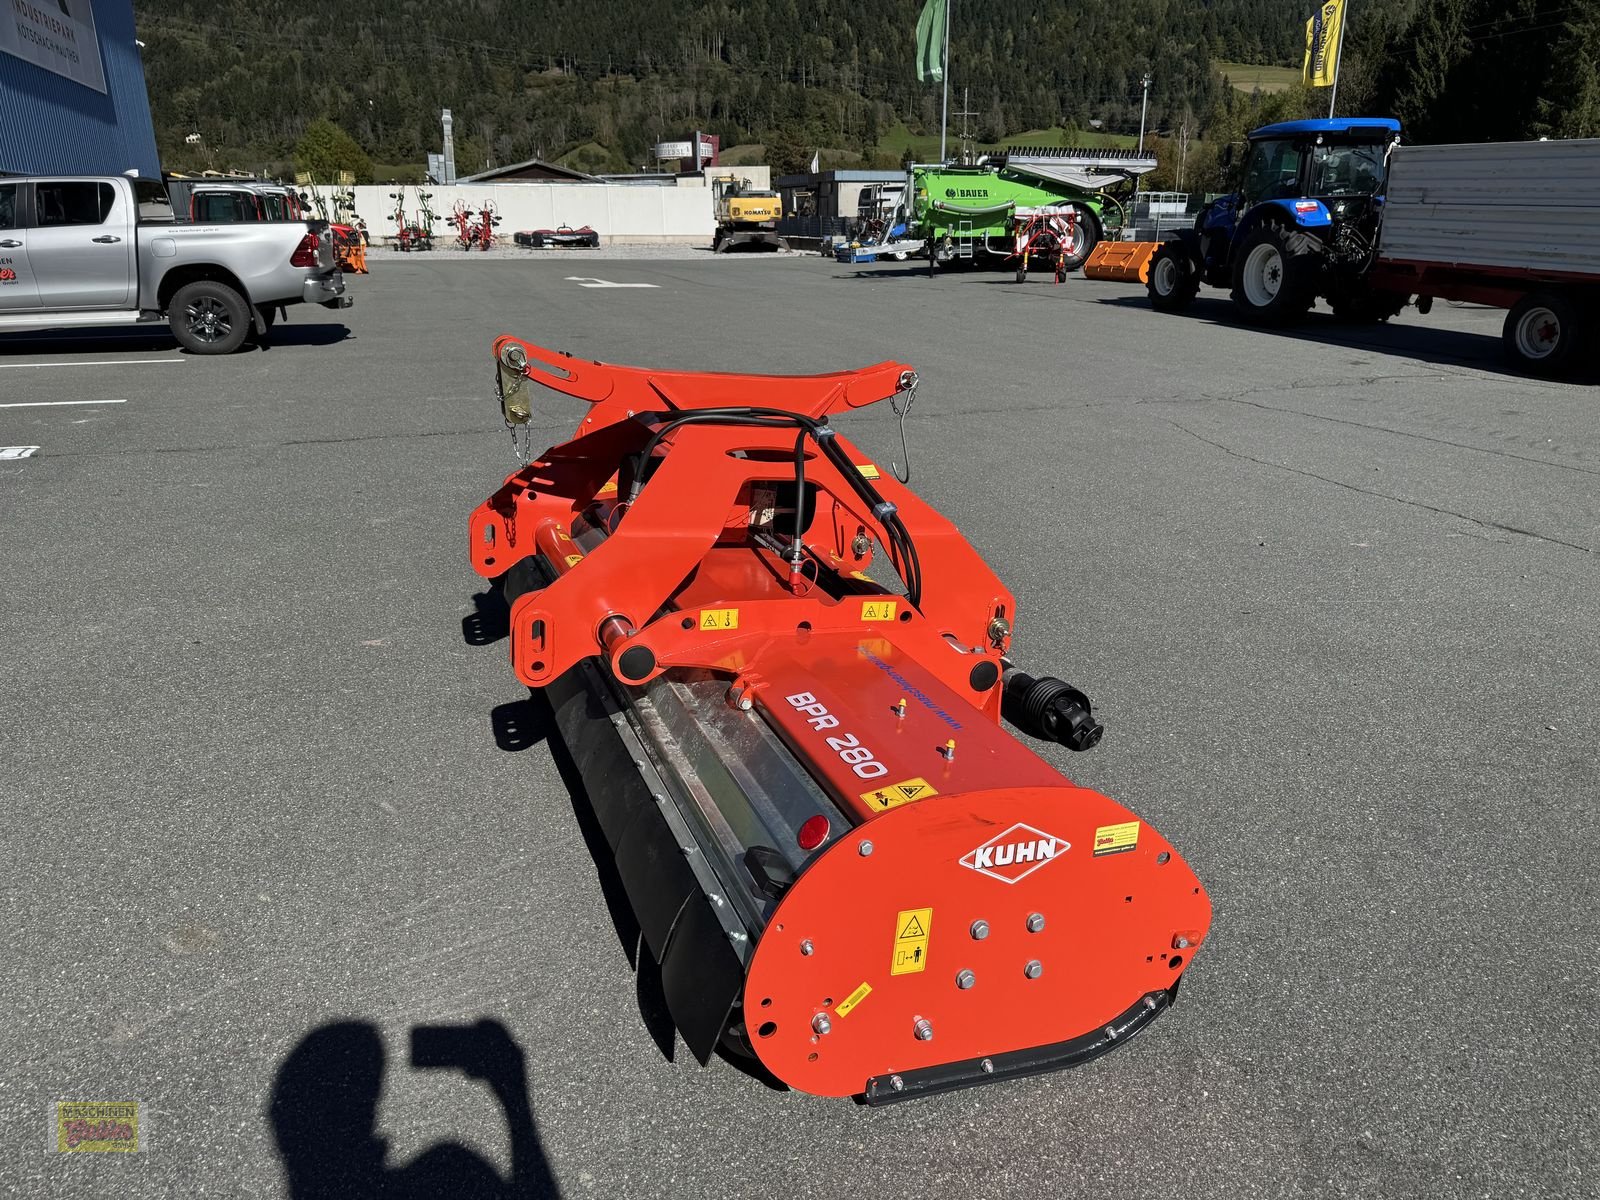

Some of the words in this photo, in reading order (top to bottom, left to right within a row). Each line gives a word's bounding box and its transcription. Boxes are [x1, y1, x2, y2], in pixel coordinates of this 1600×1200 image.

[960, 189, 988, 198] BAUER
[784, 691, 840, 731] BPR
[825, 733, 889, 779] 280
[974, 838, 1057, 869] KUHN
